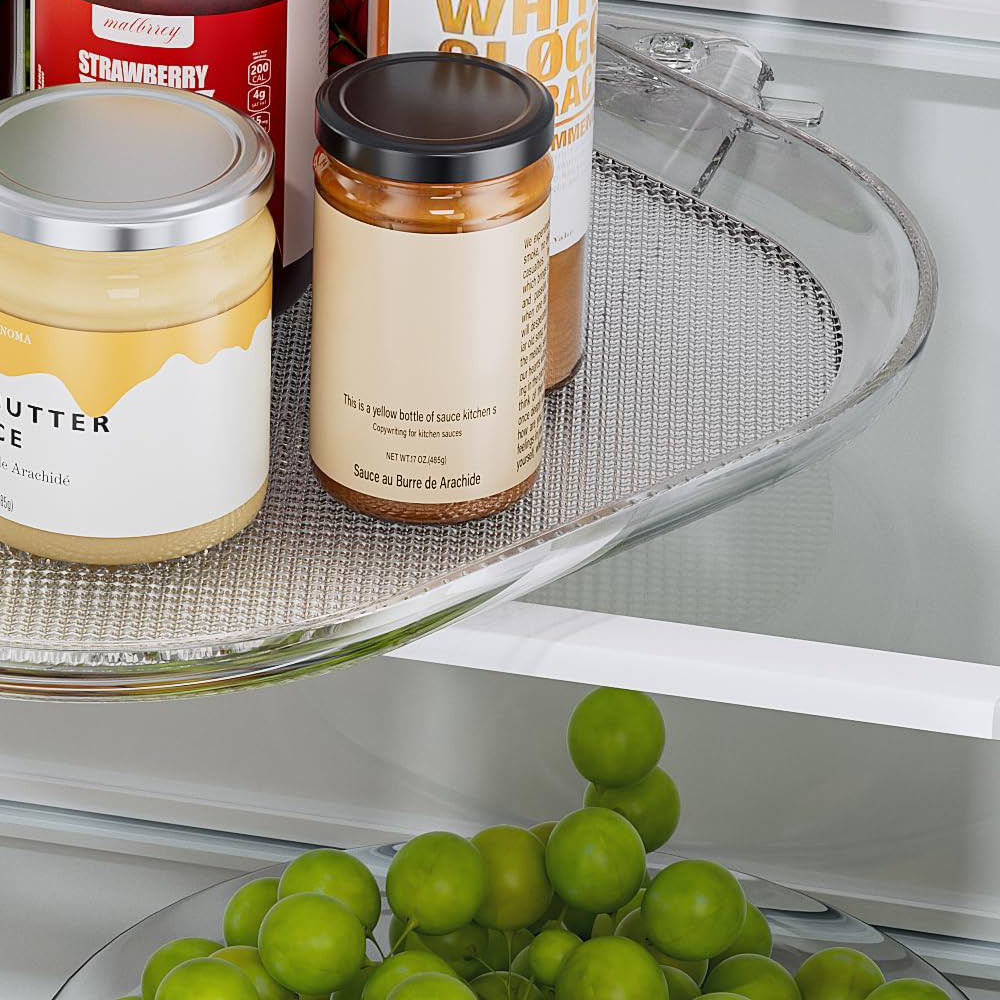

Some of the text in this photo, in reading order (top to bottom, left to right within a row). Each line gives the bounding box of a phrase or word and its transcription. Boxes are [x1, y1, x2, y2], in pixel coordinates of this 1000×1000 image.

[78, 49, 208, 88] STRAWBERRY
[251, 62, 269, 76] 200
[252, 74, 266, 82] CAL
[253, 90, 266, 100] 4g
[522, 293, 531, 308] and
[344, 392, 497, 422] This is a yellow bottle of sauce kitchen s
[372, 423, 462, 438] Copywriting for kitchen sauces
[386, 452, 399, 461] NET
[12, 463, 70, 486] Arachidé
[354, 464, 481, 489] Sauce au Burre de Arachide
